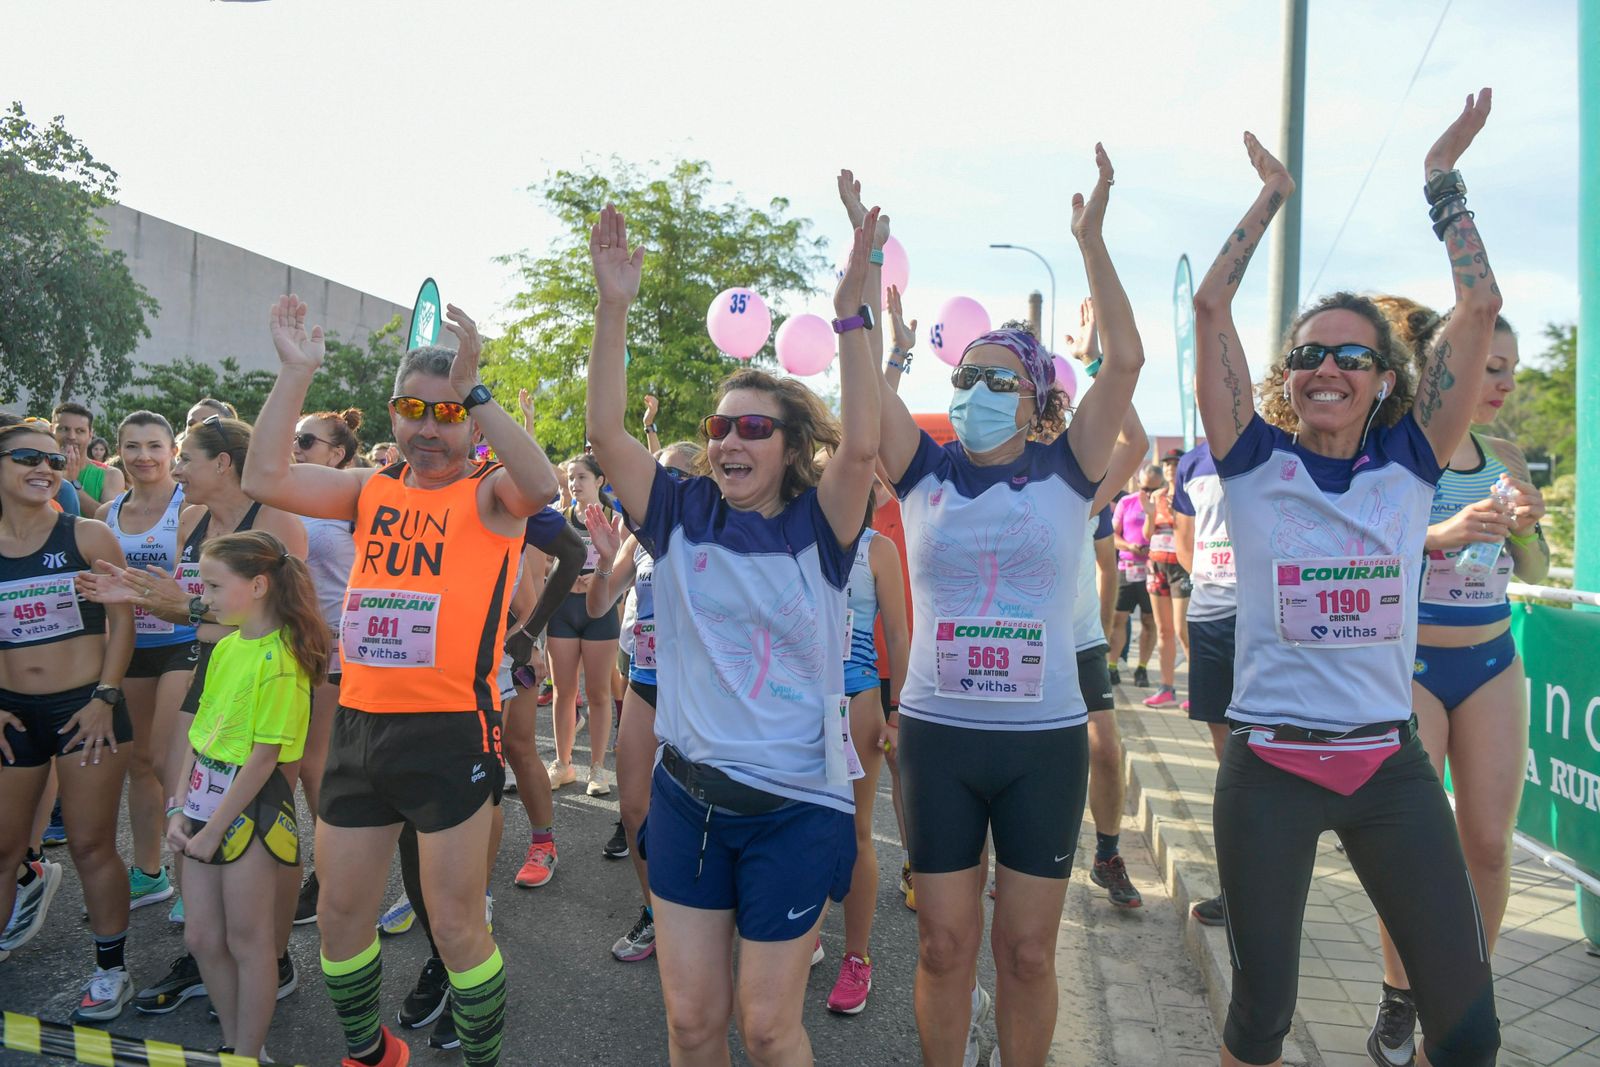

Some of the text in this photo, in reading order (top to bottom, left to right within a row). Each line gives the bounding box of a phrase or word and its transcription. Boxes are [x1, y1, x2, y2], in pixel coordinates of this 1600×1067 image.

[730, 294, 750, 314] 35'
[370, 505, 450, 541] RUN
[362, 540, 444, 576] RUN
[1211, 552, 1231, 565] 512
[1301, 565, 1400, 581] COVIRAN
[0, 585, 70, 602] COVIRAN
[1465, 590, 1494, 599] vithas
[360, 597, 435, 611] COVIRAN
[1316, 589, 1370, 614] 1190
[13, 602, 47, 620] 456
[1329, 614, 1360, 622] CRISTINA
[25, 622, 60, 634] vithas
[367, 616, 399, 637] 641
[955, 626, 1042, 640] COVIRAN
[1333, 626, 1377, 638] vithas
[370, 648, 407, 659] vithas
[968, 646, 1009, 669] 563
[983, 669, 1009, 677] ANTONIO
[977, 680, 1017, 692] vithas
